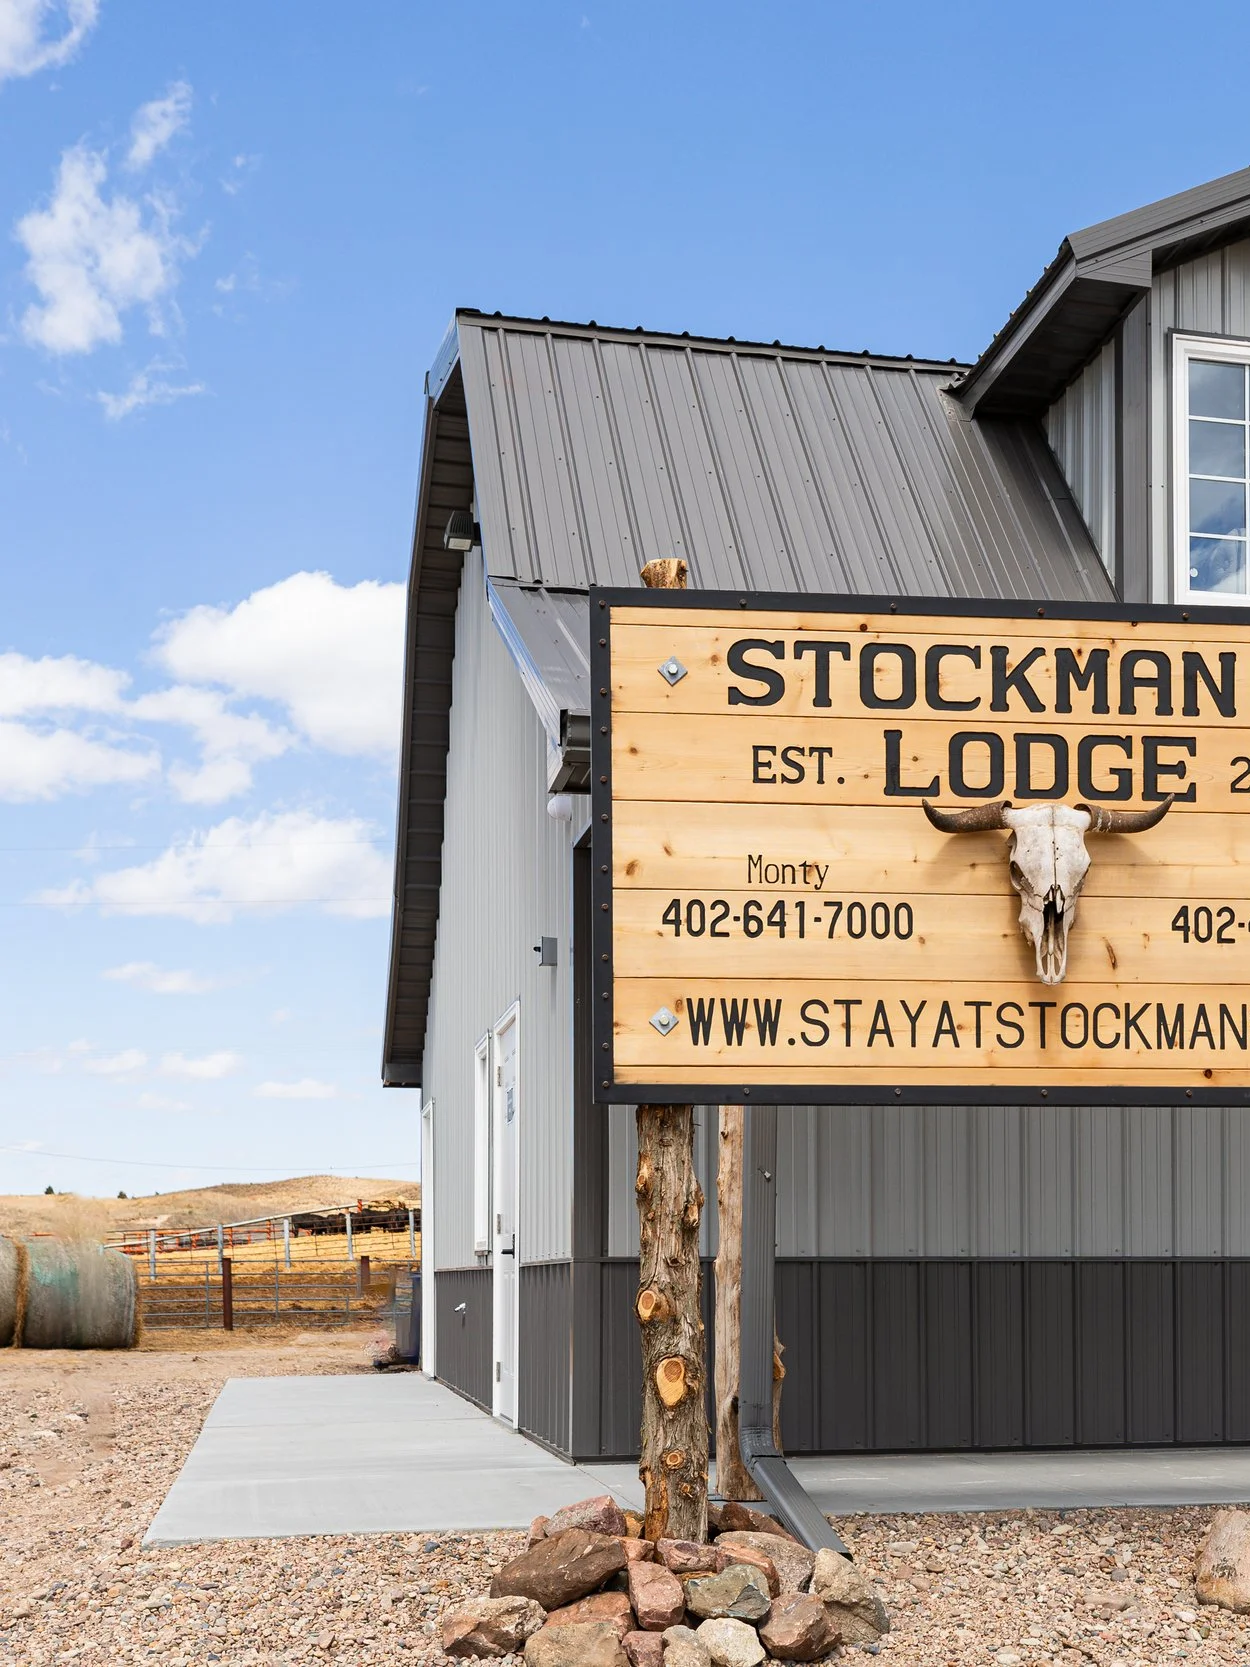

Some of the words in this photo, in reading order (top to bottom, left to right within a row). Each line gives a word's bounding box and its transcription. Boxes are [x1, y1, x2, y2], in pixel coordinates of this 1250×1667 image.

[752, 745, 845, 785] EST.
[883, 729, 1197, 802] LODGE
[747, 854, 829, 890] Monty
[662, 898, 914, 940] 402-641-7000
